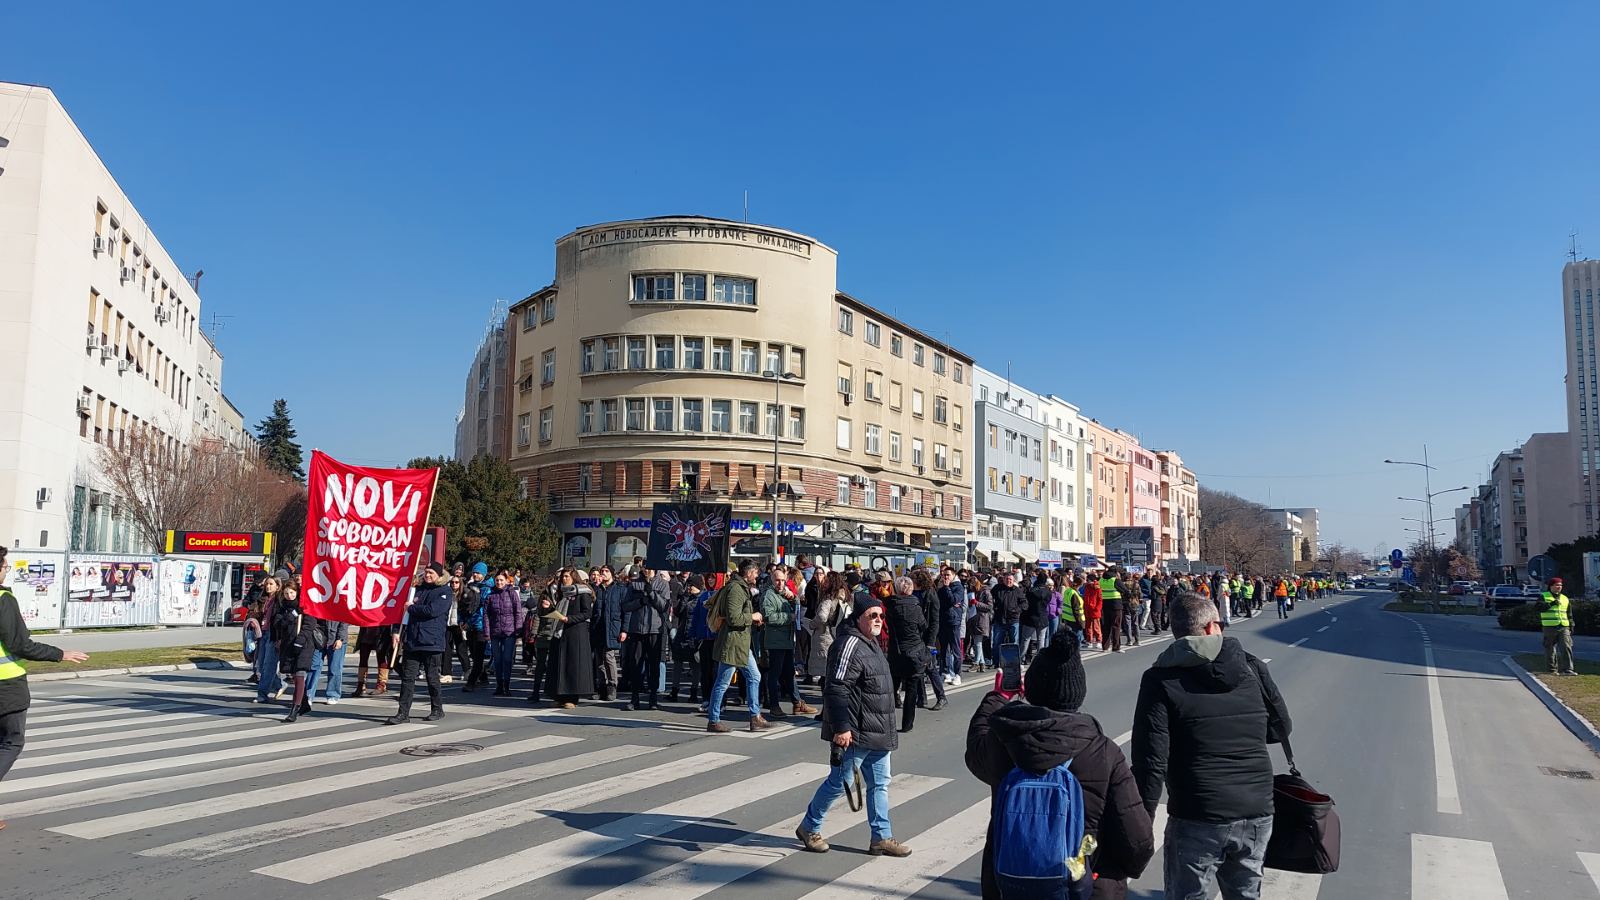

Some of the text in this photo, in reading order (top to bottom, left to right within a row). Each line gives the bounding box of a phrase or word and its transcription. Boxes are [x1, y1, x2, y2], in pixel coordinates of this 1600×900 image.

[588, 227, 803, 253] ДОМ НОВОСАДСКЕ ТРГОВАЧКЕ ОМЛАДИНЕ
[324, 473, 422, 525] NOVI
[318, 516, 413, 548] SLOBODAN
[574, 517, 653, 531] BENU Apote
[730, 518, 749, 530] NU
[188, 537, 248, 547] Corner Kiosk
[316, 541, 413, 569] UNIVERZITET
[307, 560, 409, 610] SAD!
